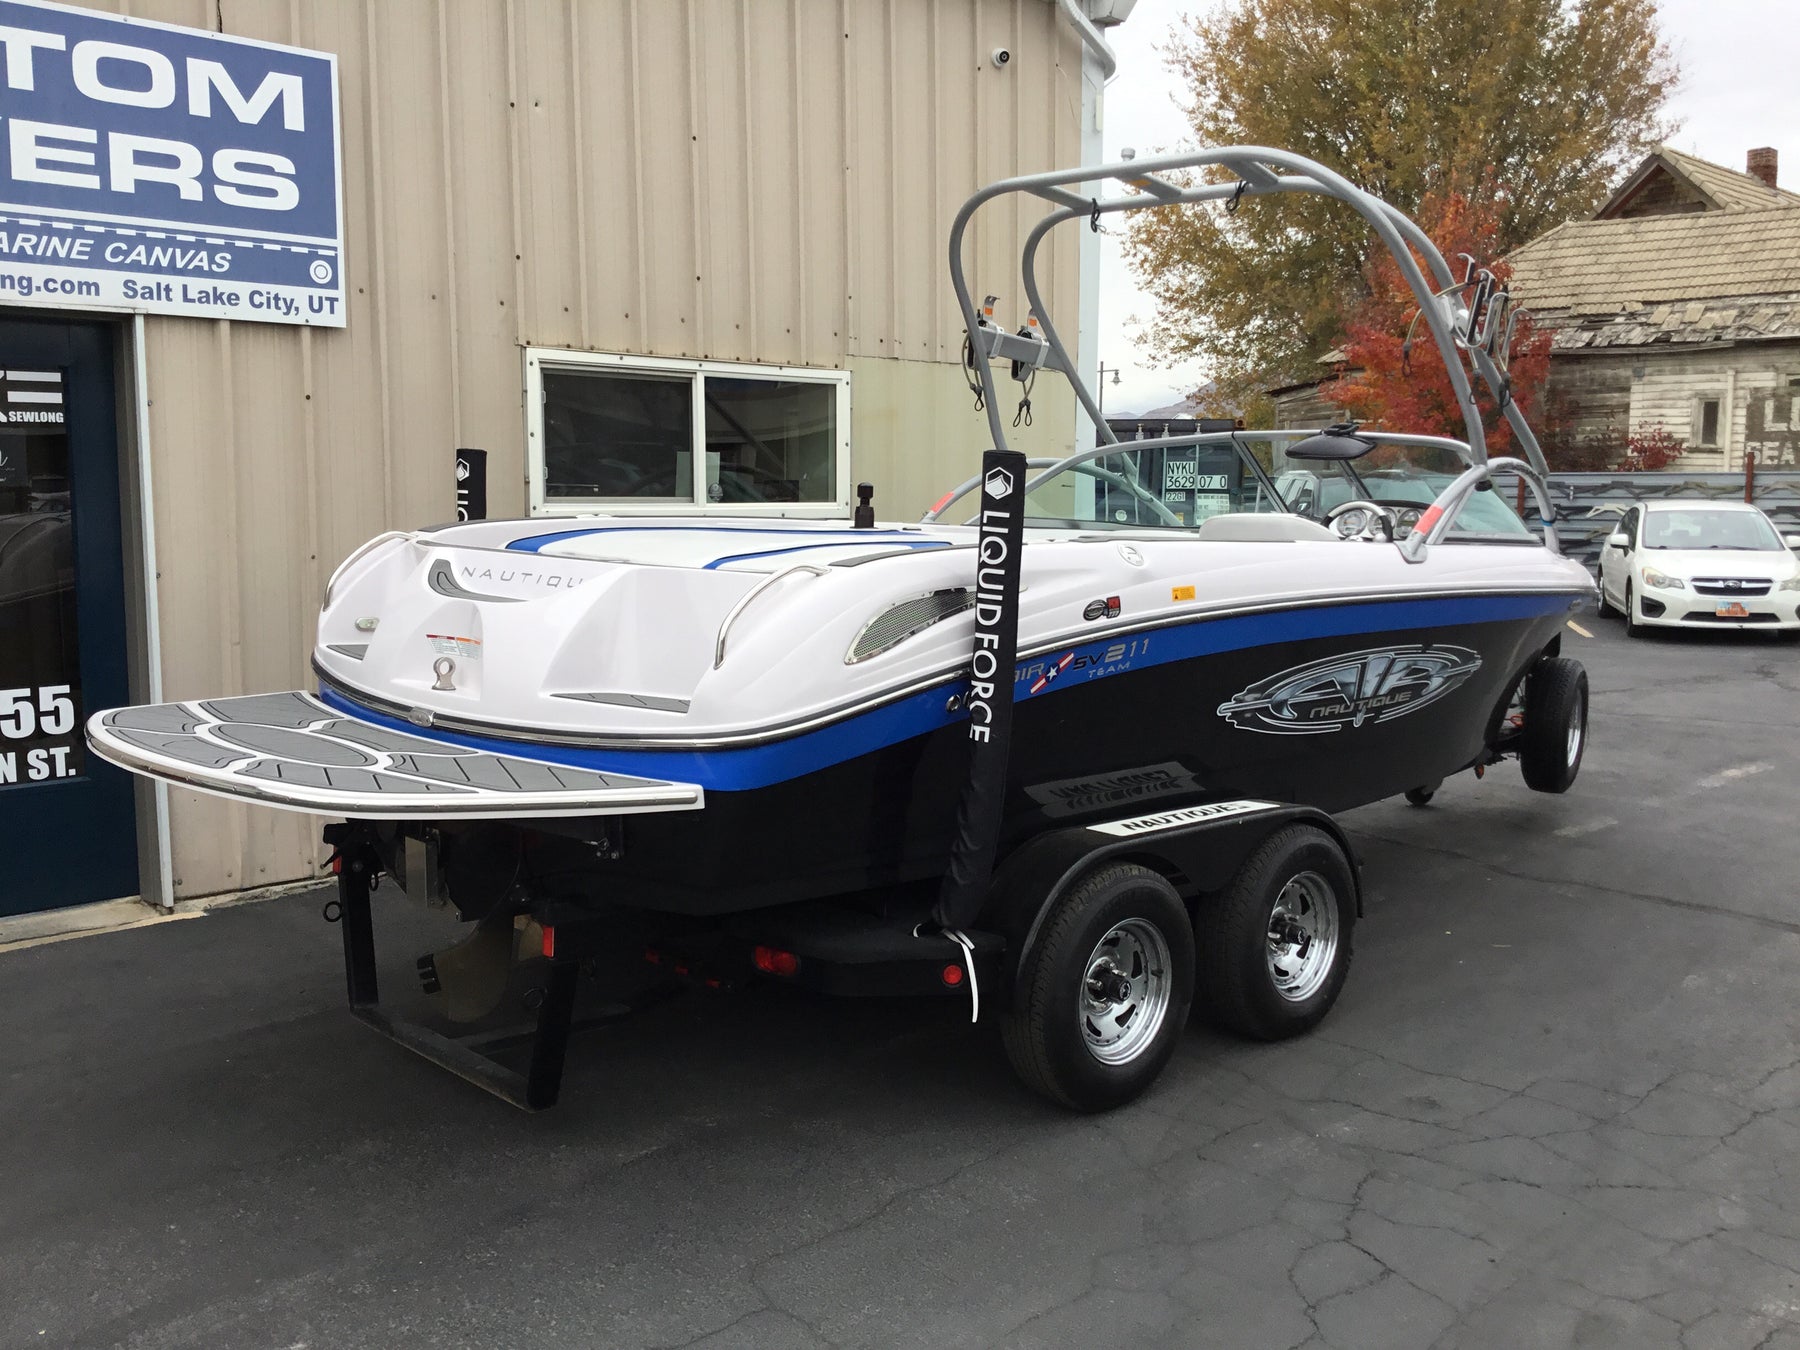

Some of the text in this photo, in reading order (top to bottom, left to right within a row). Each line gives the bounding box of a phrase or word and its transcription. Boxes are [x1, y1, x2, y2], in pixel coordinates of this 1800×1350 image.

[0, 25, 305, 132] TOM
[0, 116, 300, 212] ERS
[104, 241, 232, 273] CANVAS
[0, 273, 339, 316] ng.com Salt Lake City, UT
[8, 410, 64, 423] SEWLONG
[1167, 462, 1196, 475] NYKU
[1167, 476, 1227, 488] 3629 07 0
[969, 510, 1010, 743] LIQUID FORCE
[1014, 663, 1045, 683] IR
[1088, 661, 1131, 678] TEAM
[0, 684, 75, 739] 55
[1309, 690, 1412, 719] NAUTIQUE
[26, 746, 76, 780] ST.
